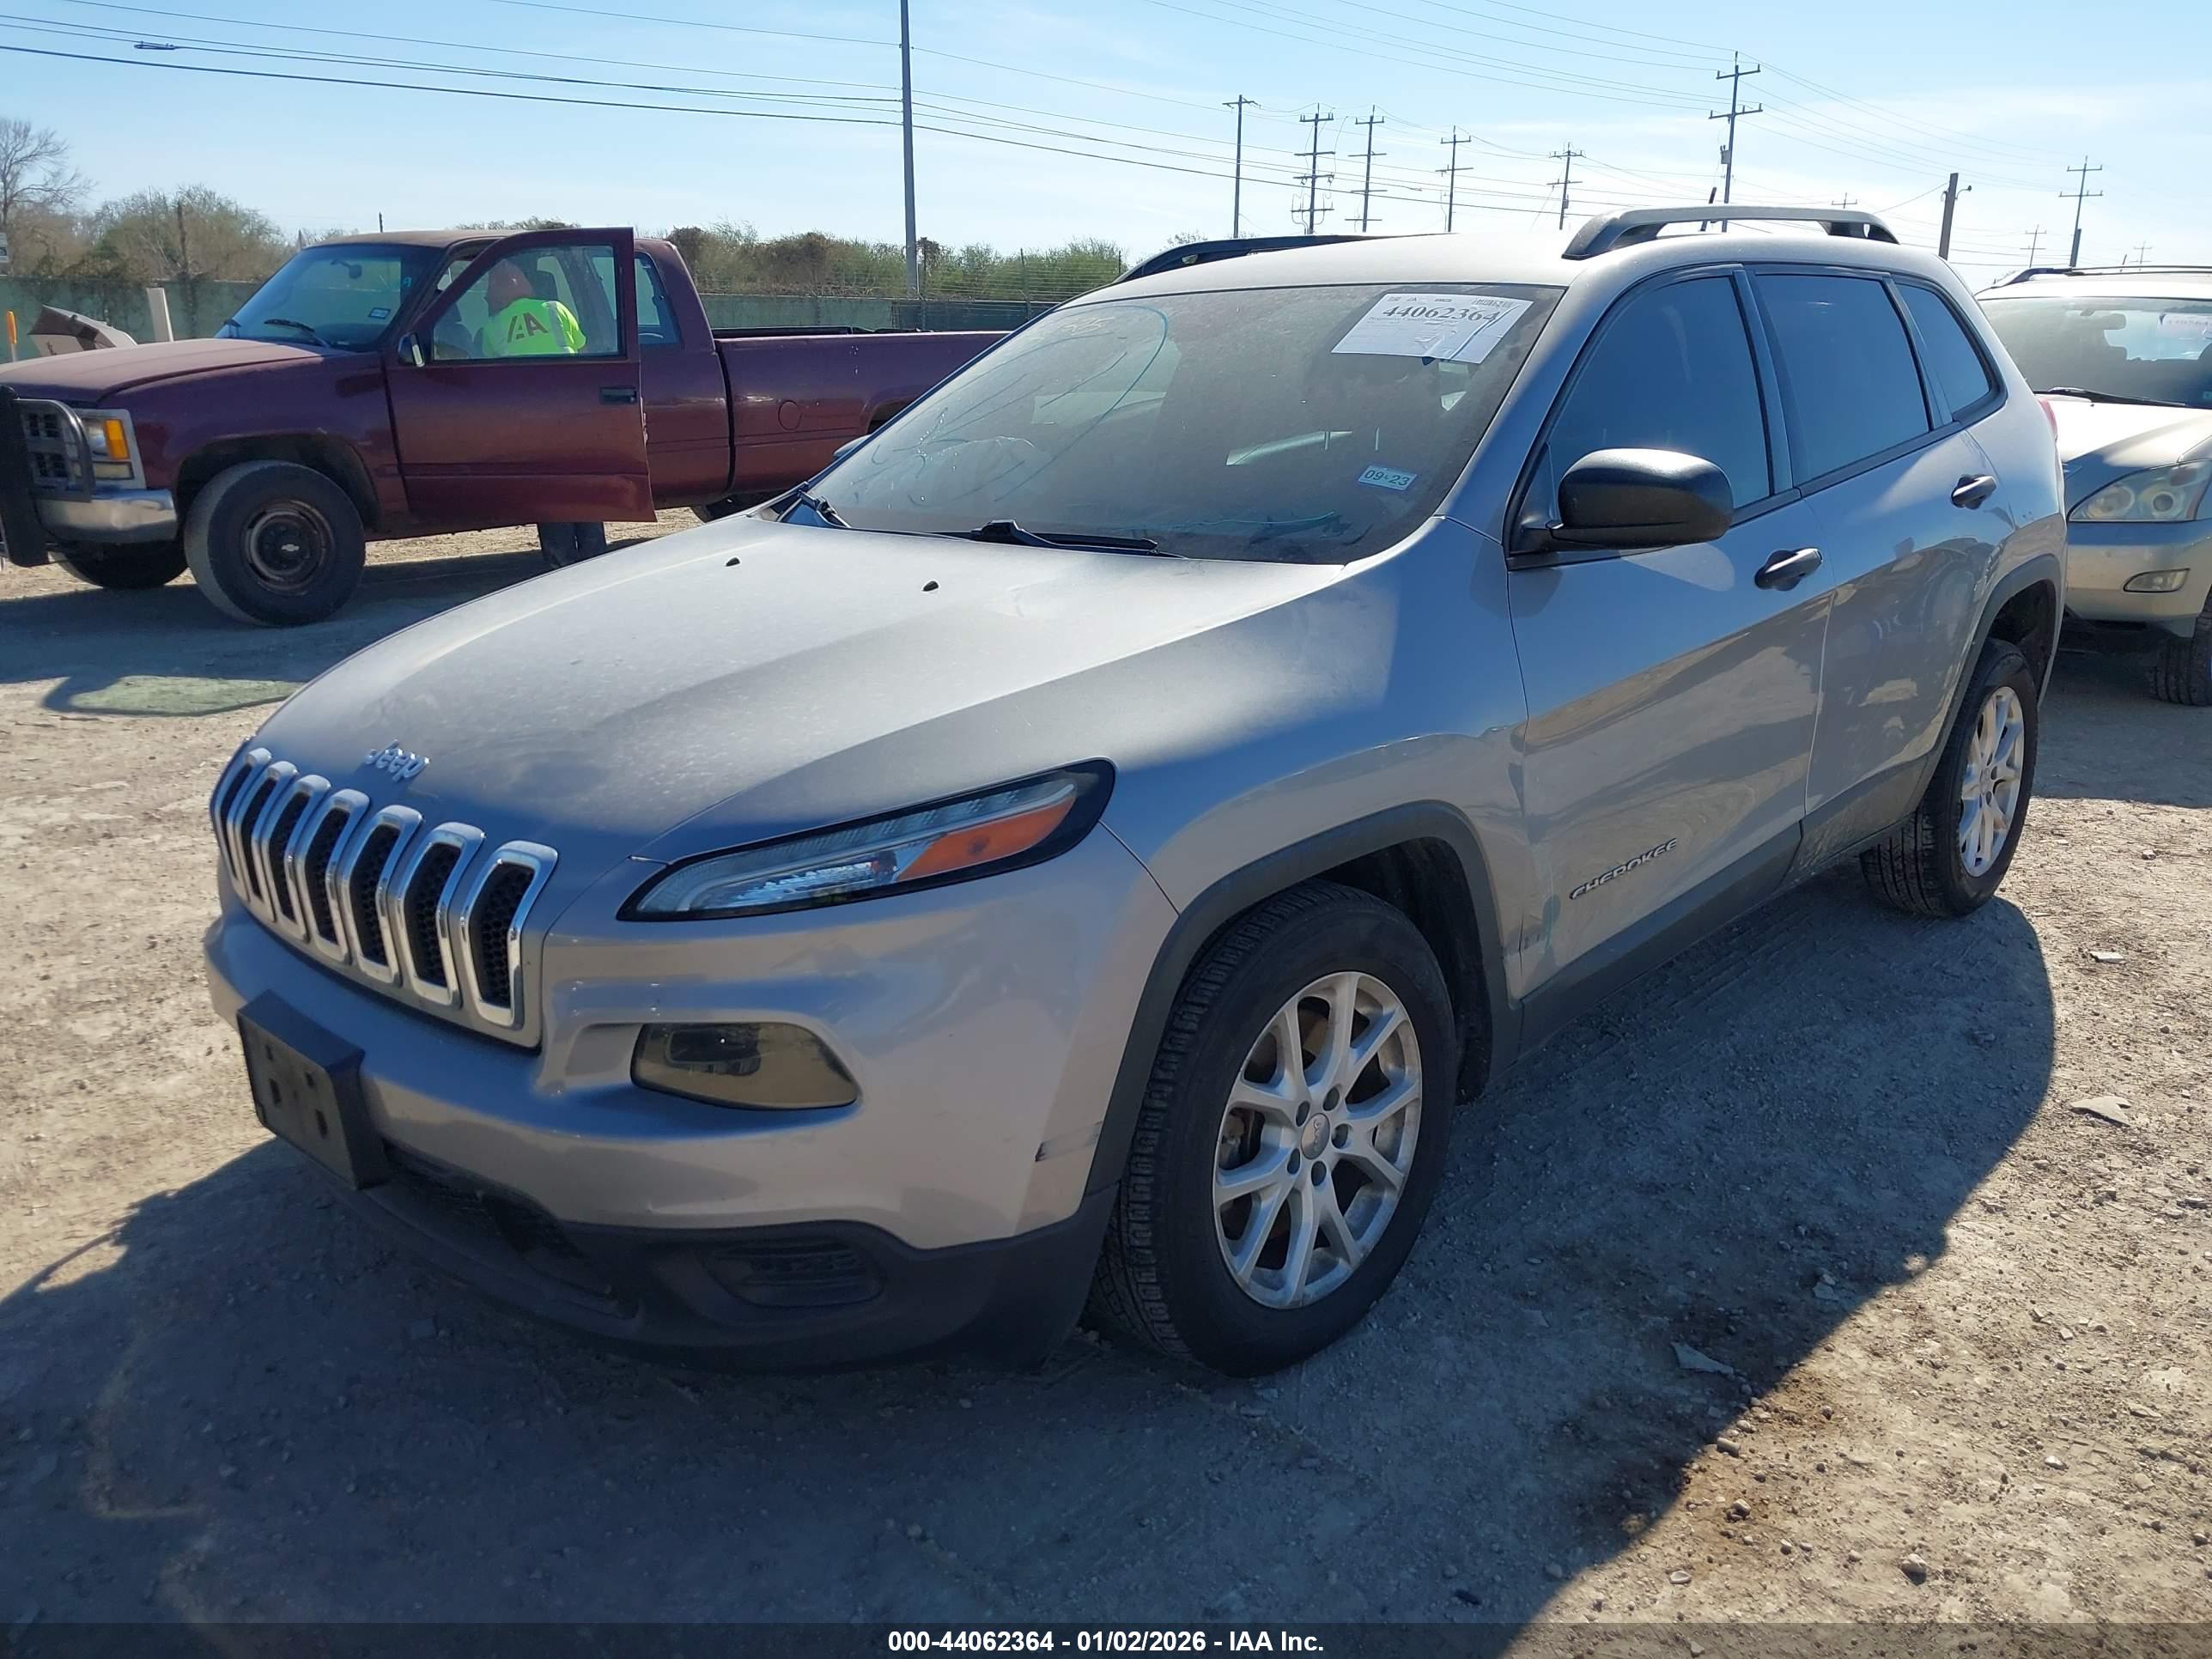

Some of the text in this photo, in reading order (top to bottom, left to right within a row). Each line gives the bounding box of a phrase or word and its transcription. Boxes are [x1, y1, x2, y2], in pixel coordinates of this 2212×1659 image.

[1382, 305, 1500, 322] 44062364
[364, 738, 430, 783] Jeep
[1569, 837, 1677, 900] CHEROKEE
